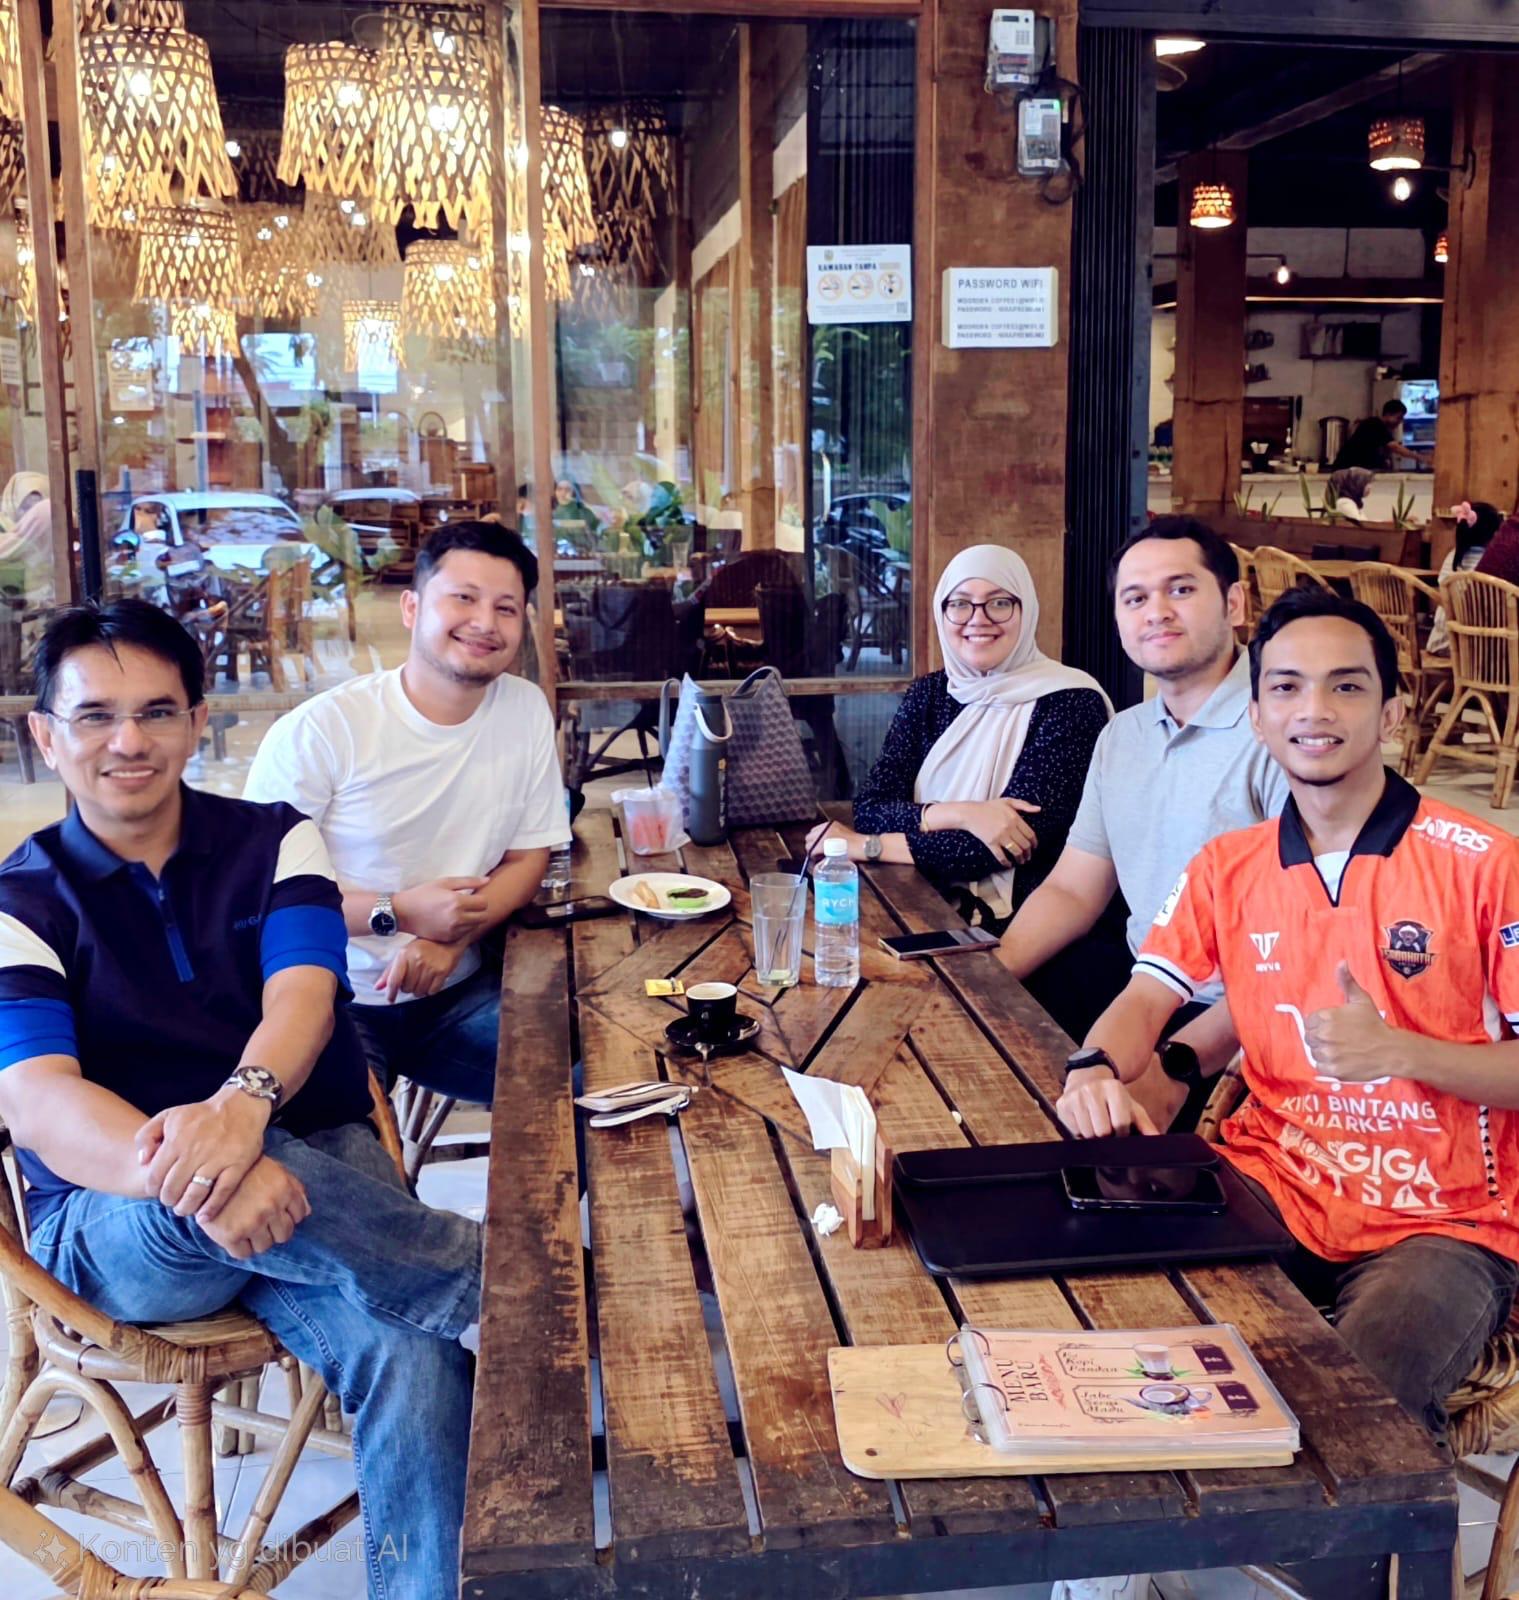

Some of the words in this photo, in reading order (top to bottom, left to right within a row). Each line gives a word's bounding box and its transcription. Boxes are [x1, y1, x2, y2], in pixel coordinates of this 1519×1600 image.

[958, 279, 1017, 289] PASSWORD
[1021, 279, 1043, 289] WIFI
[1281, 1093, 1320, 1112] KIKI
[1327, 1095, 1437, 1121] BINTANG
[1337, 1142, 1441, 1187] GIGA
[996, 1359, 1029, 1403] MENU
[1014, 1360, 1050, 1402] BARU
